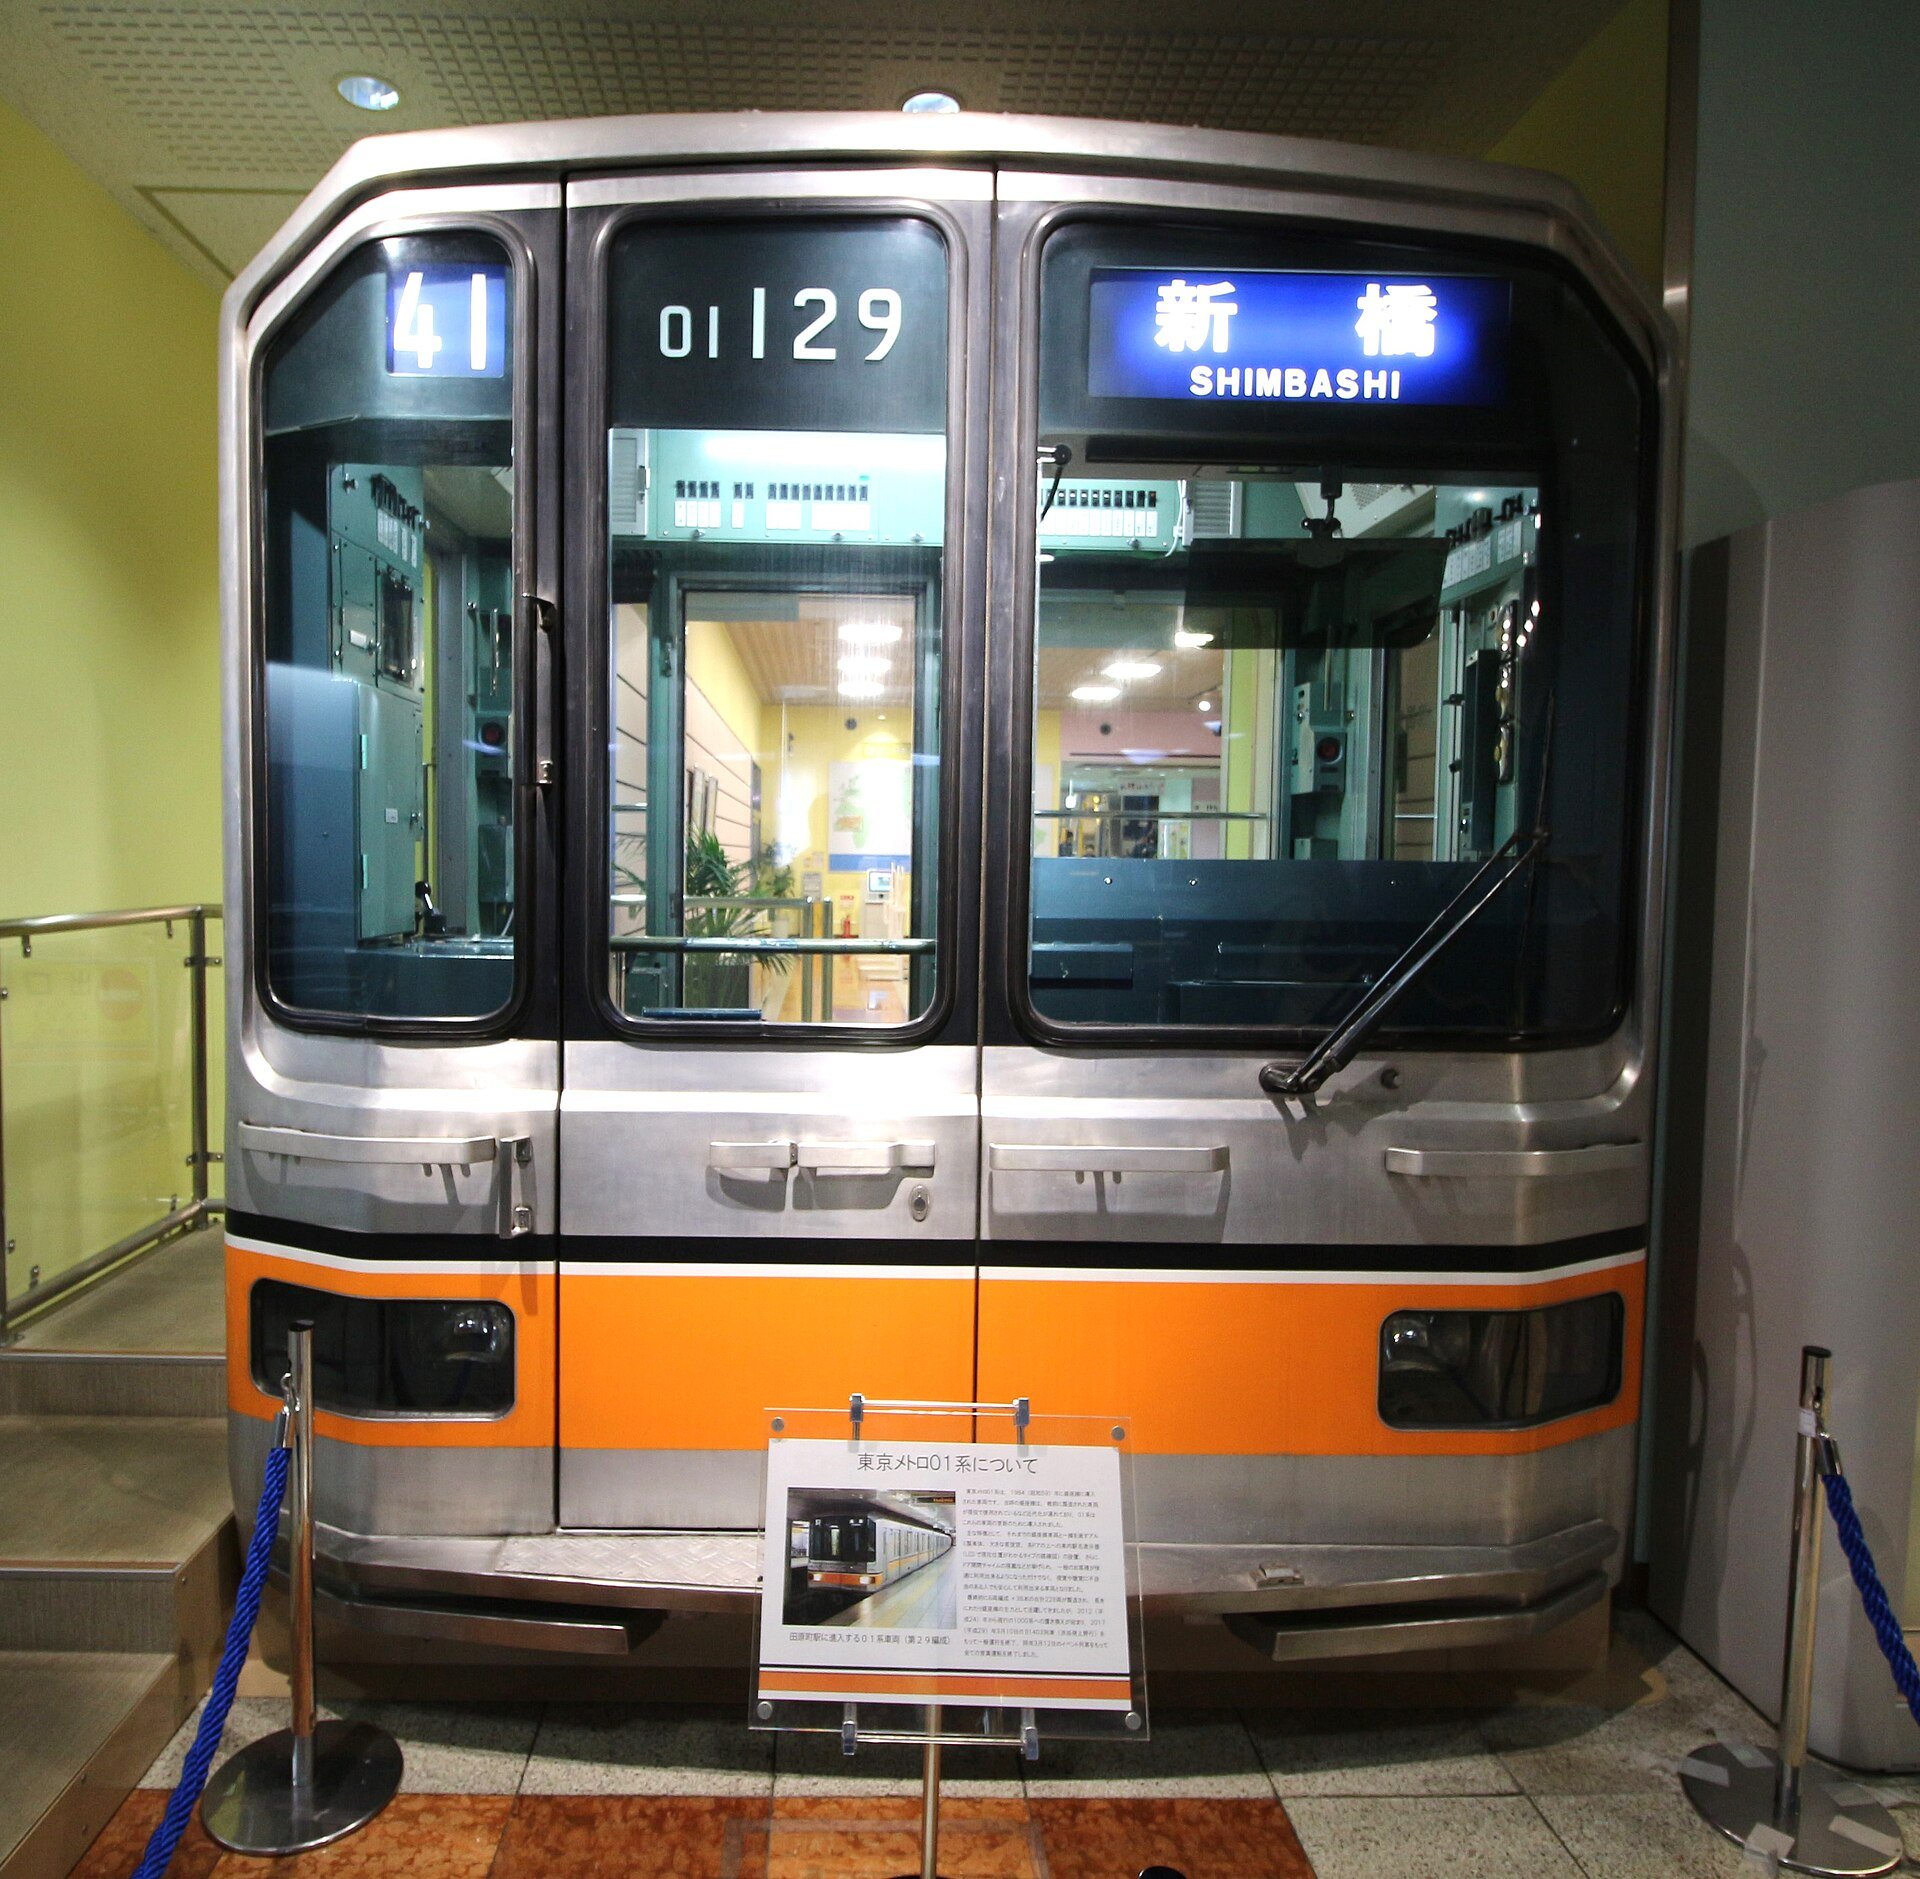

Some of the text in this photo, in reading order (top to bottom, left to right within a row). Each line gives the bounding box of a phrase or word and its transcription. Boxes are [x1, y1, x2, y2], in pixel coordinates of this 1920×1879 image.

[393, 271, 487, 371] 41
[1188, 365, 1401, 400] SHIMBASHI
[857, 1453, 1038, 1474] 東京メトロ01系について
